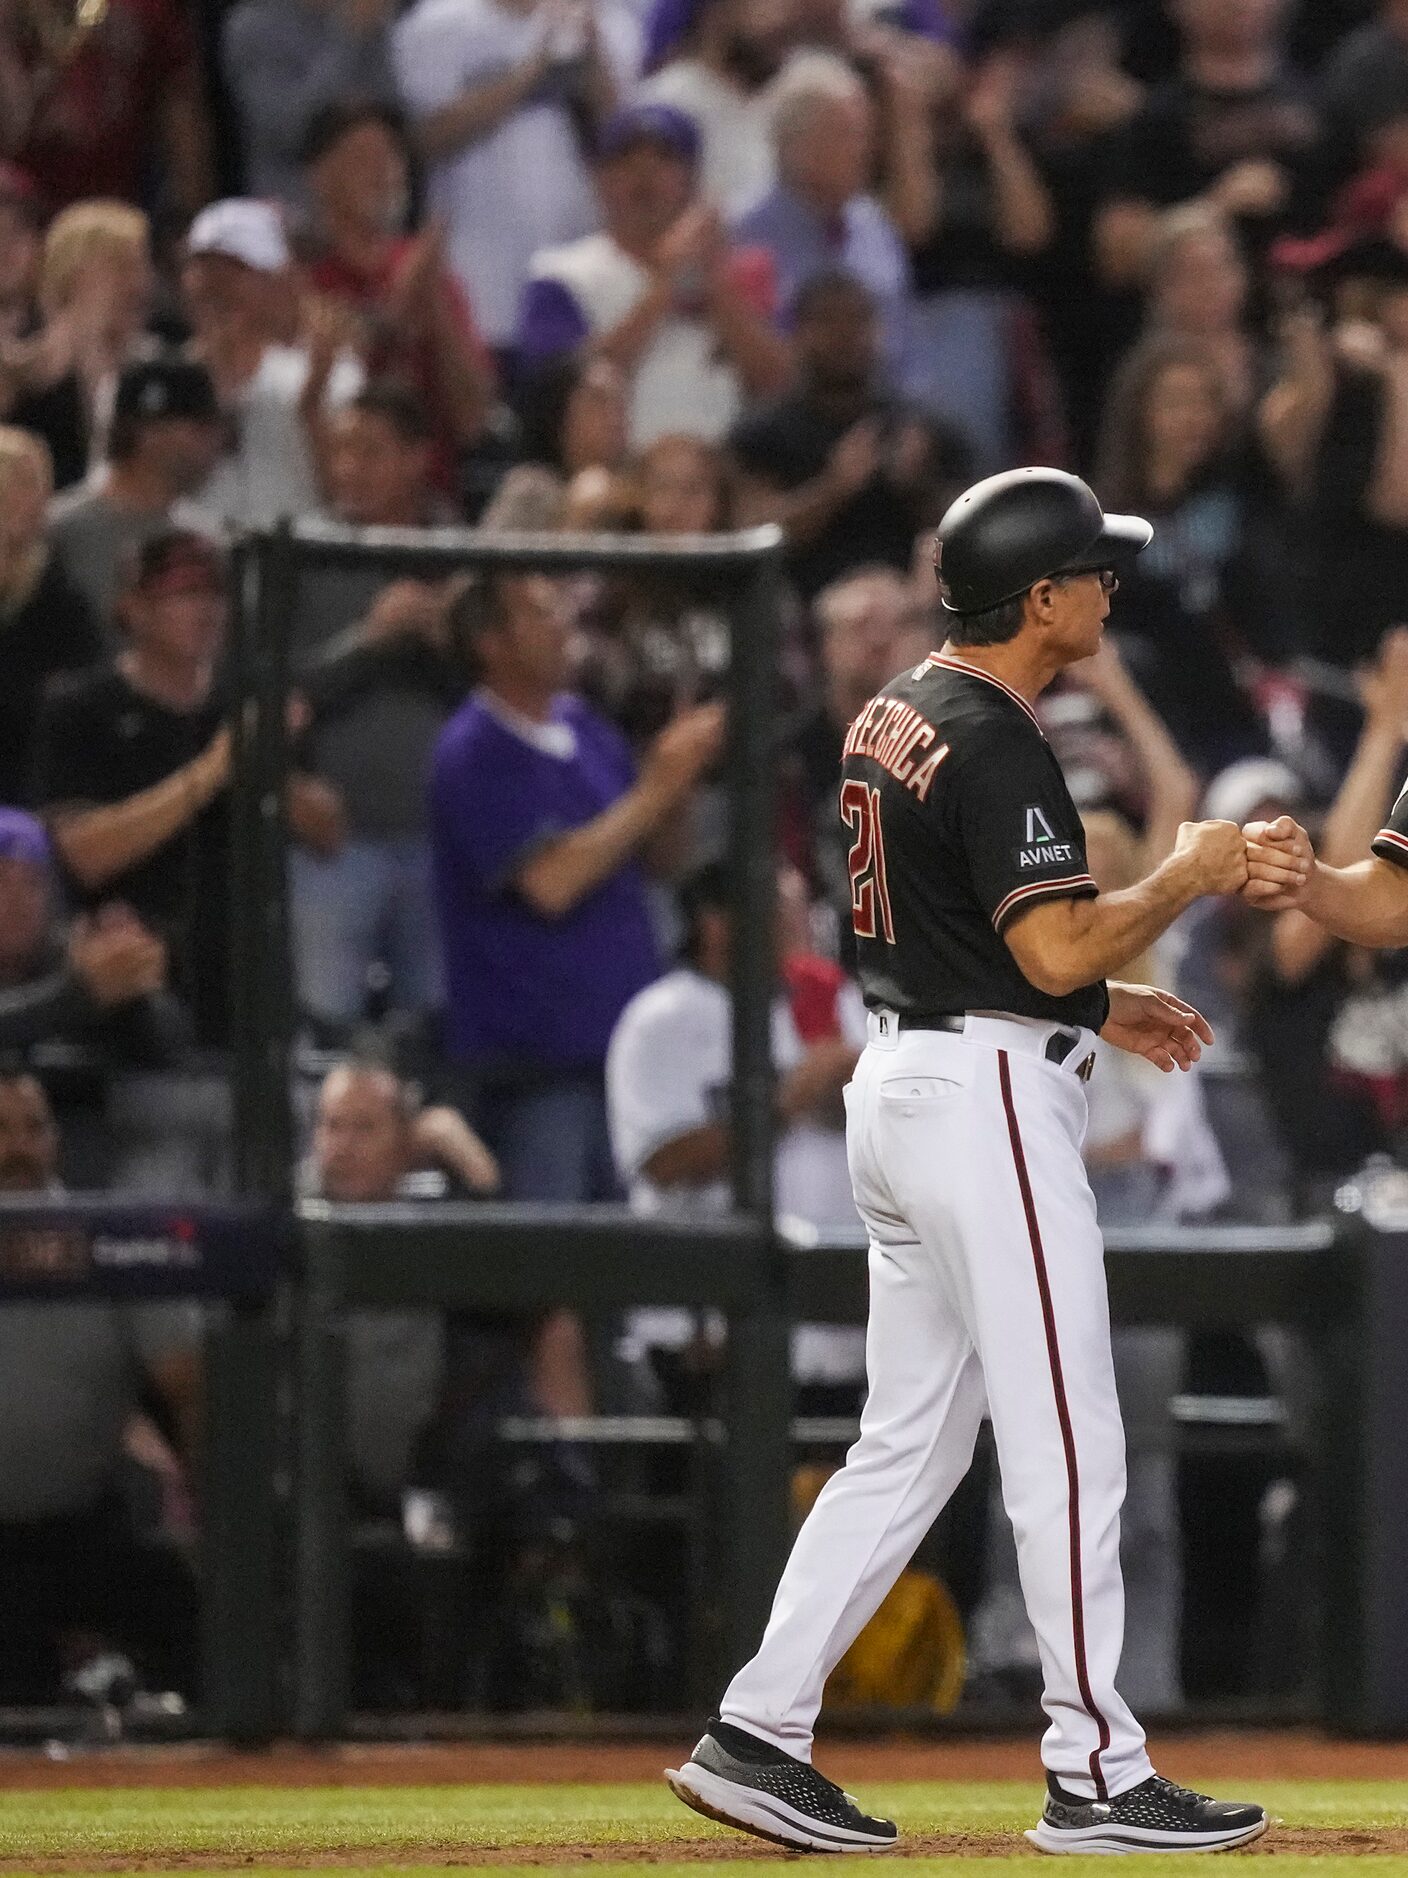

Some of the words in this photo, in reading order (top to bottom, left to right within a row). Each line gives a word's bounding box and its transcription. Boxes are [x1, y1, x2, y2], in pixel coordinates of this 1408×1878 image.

[840, 696, 950, 803] REZCHICA
[840, 778, 897, 945] 21
[1020, 844, 1072, 867] AVNET
